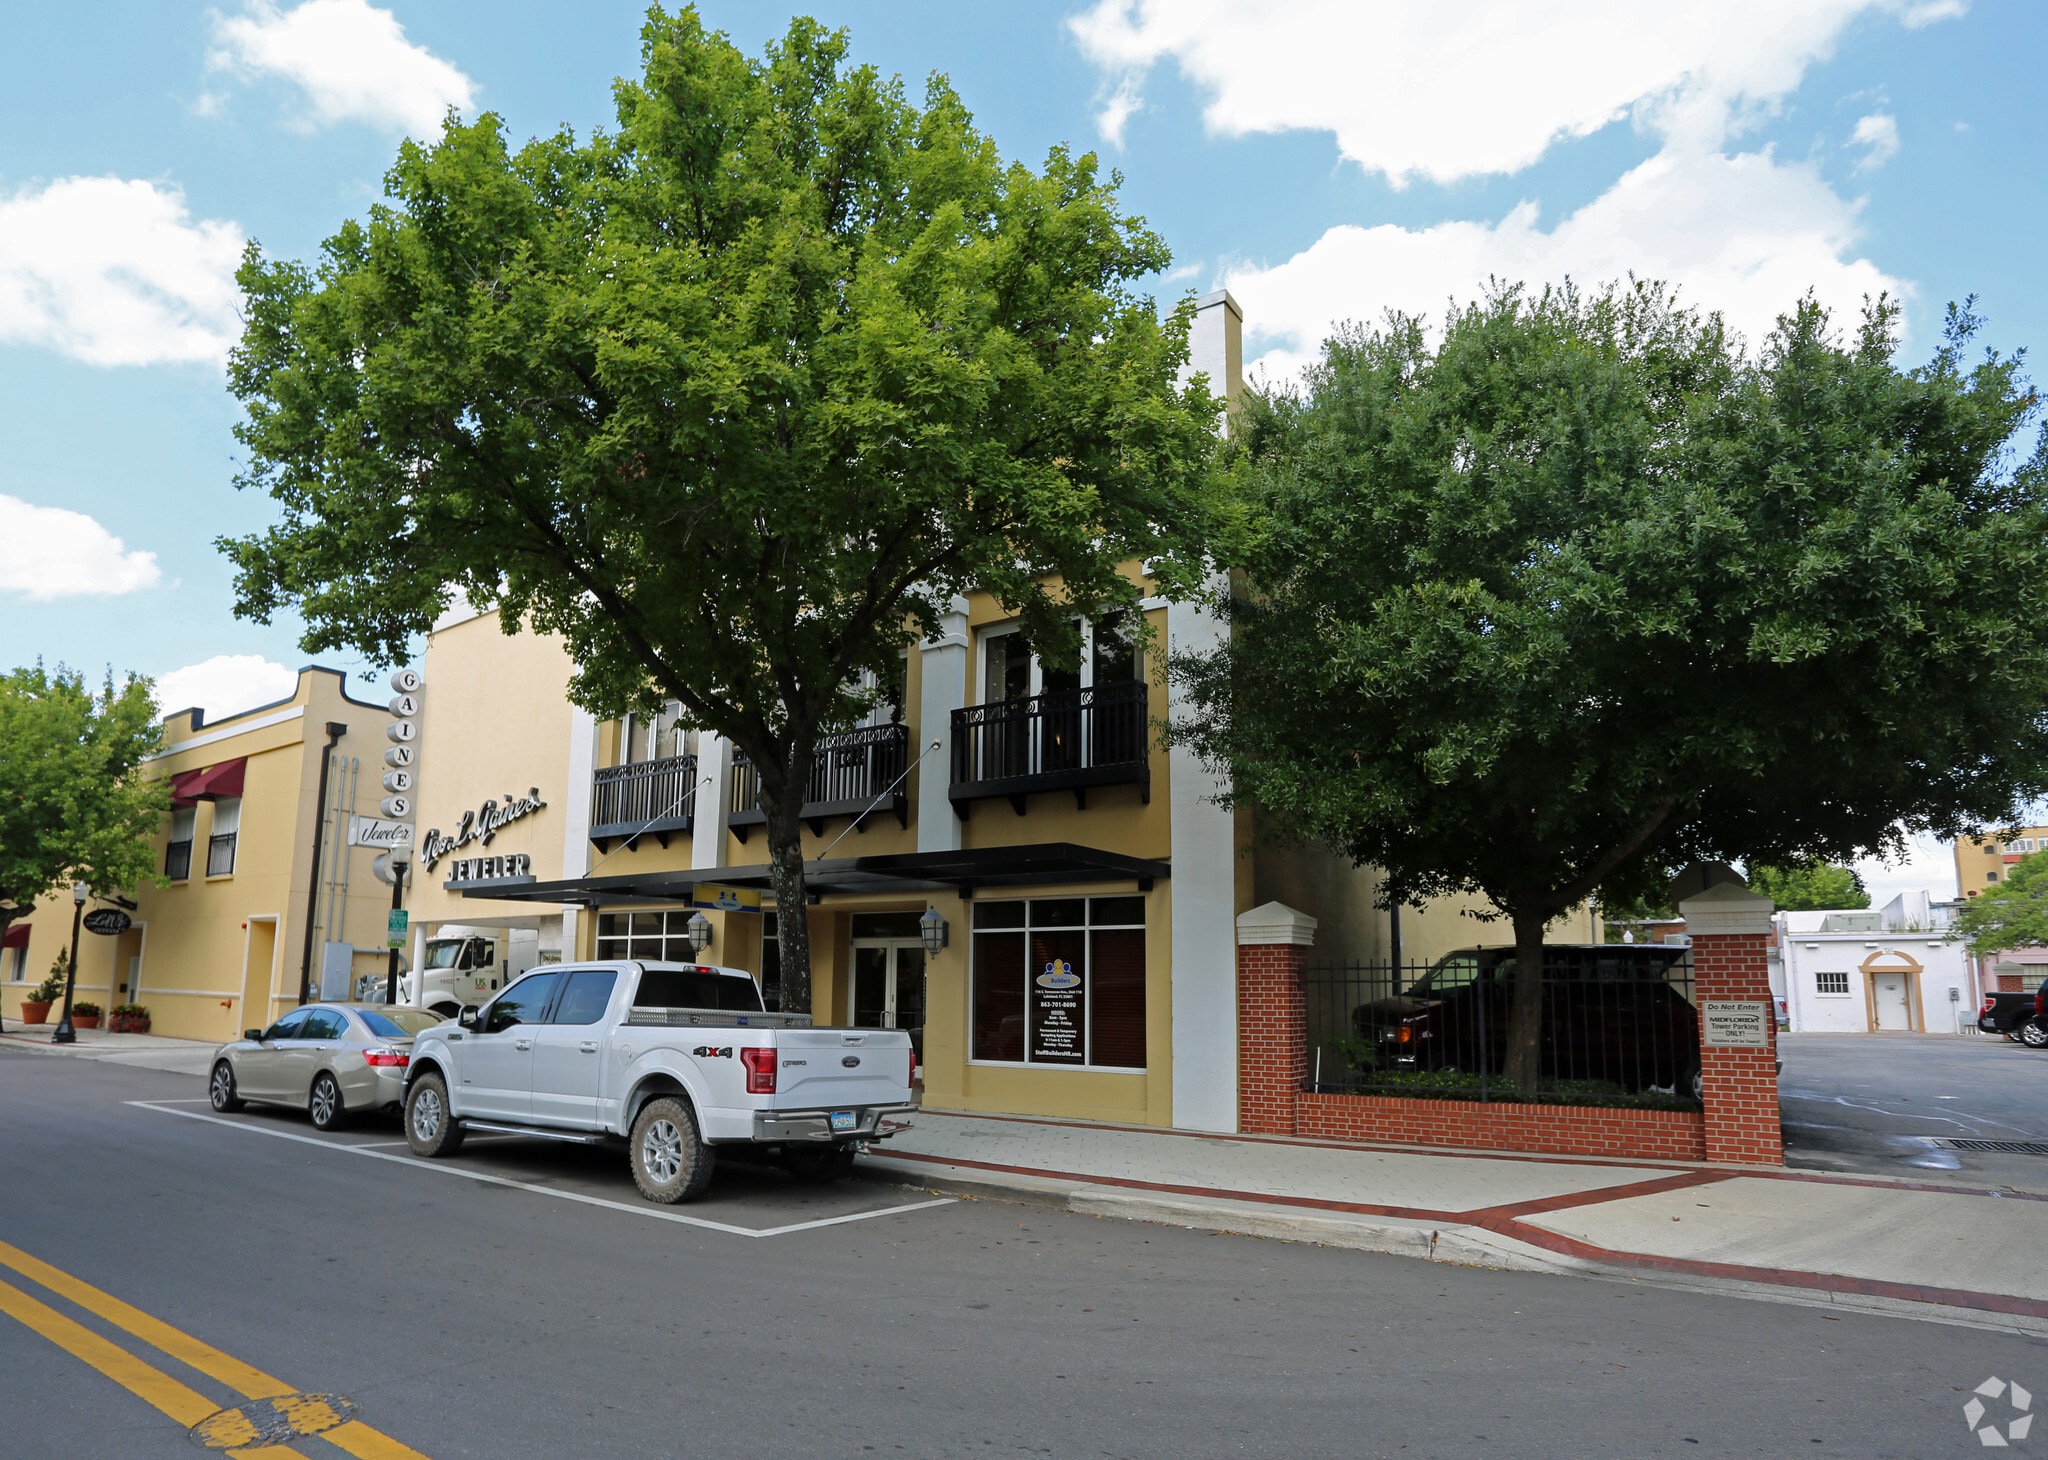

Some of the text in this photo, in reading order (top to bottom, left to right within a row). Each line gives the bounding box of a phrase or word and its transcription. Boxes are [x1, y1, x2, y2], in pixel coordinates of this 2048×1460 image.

[394, 673, 415, 812] GAINES
[361, 820, 410, 843] Jeweler
[475, 787, 547, 847] Gaines
[448, 853, 530, 882] JEWELER
[1733, 1023, 1760, 1031] Parking
